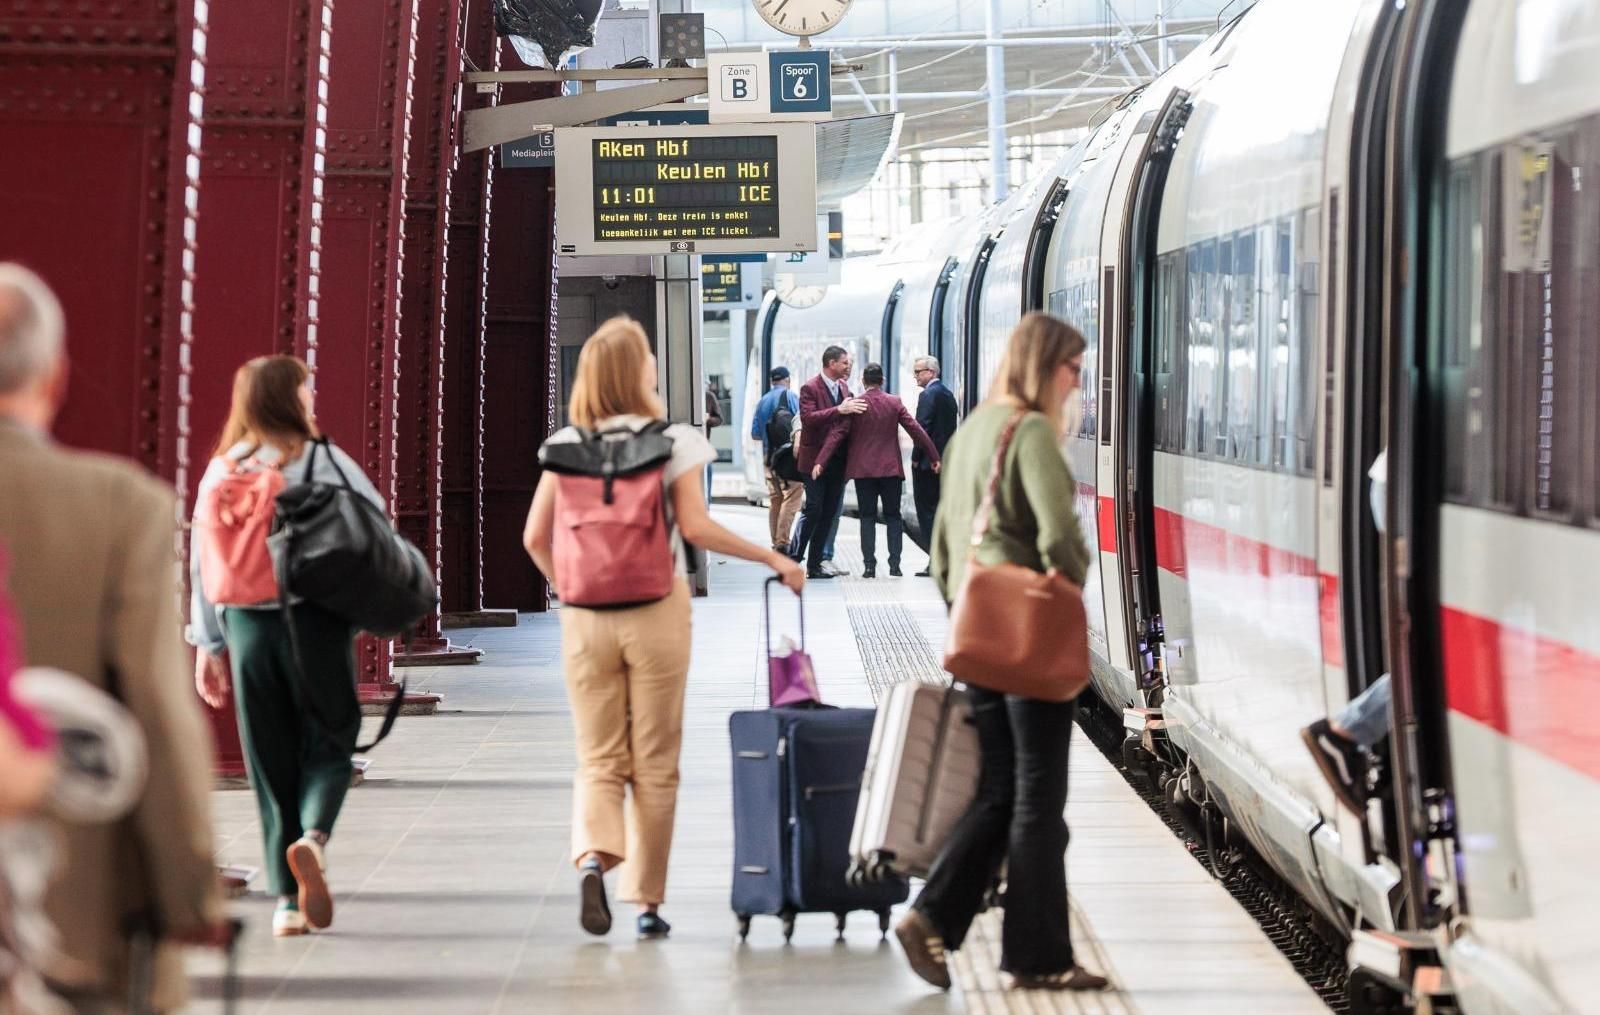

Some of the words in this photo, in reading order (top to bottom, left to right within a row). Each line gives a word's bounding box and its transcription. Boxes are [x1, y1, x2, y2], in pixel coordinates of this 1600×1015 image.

[725, 66, 751, 76] Zone
[785, 65, 814, 78] Spoor
[732, 78, 748, 99] B
[793, 76, 807, 98] 6
[544, 135, 552, 145] 5
[511, 148, 556, 159] Mediaplein
[599, 141, 645, 158] Aken
[656, 139, 688, 157] Hbf
[657, 162, 726, 180] Keulen
[737, 161, 769, 179] Hbf
[601, 187, 655, 205] 11:01
[739, 185, 771, 202] ICE
[600, 213, 630, 222] Keulen
[657, 212, 678, 221] Deze
[682, 212, 706, 221] trein
[711, 211, 721, 220] is
[724, 210, 749, 220] enkel
[681, 227, 697, 236] een
[701, 227, 716, 236] ICE
